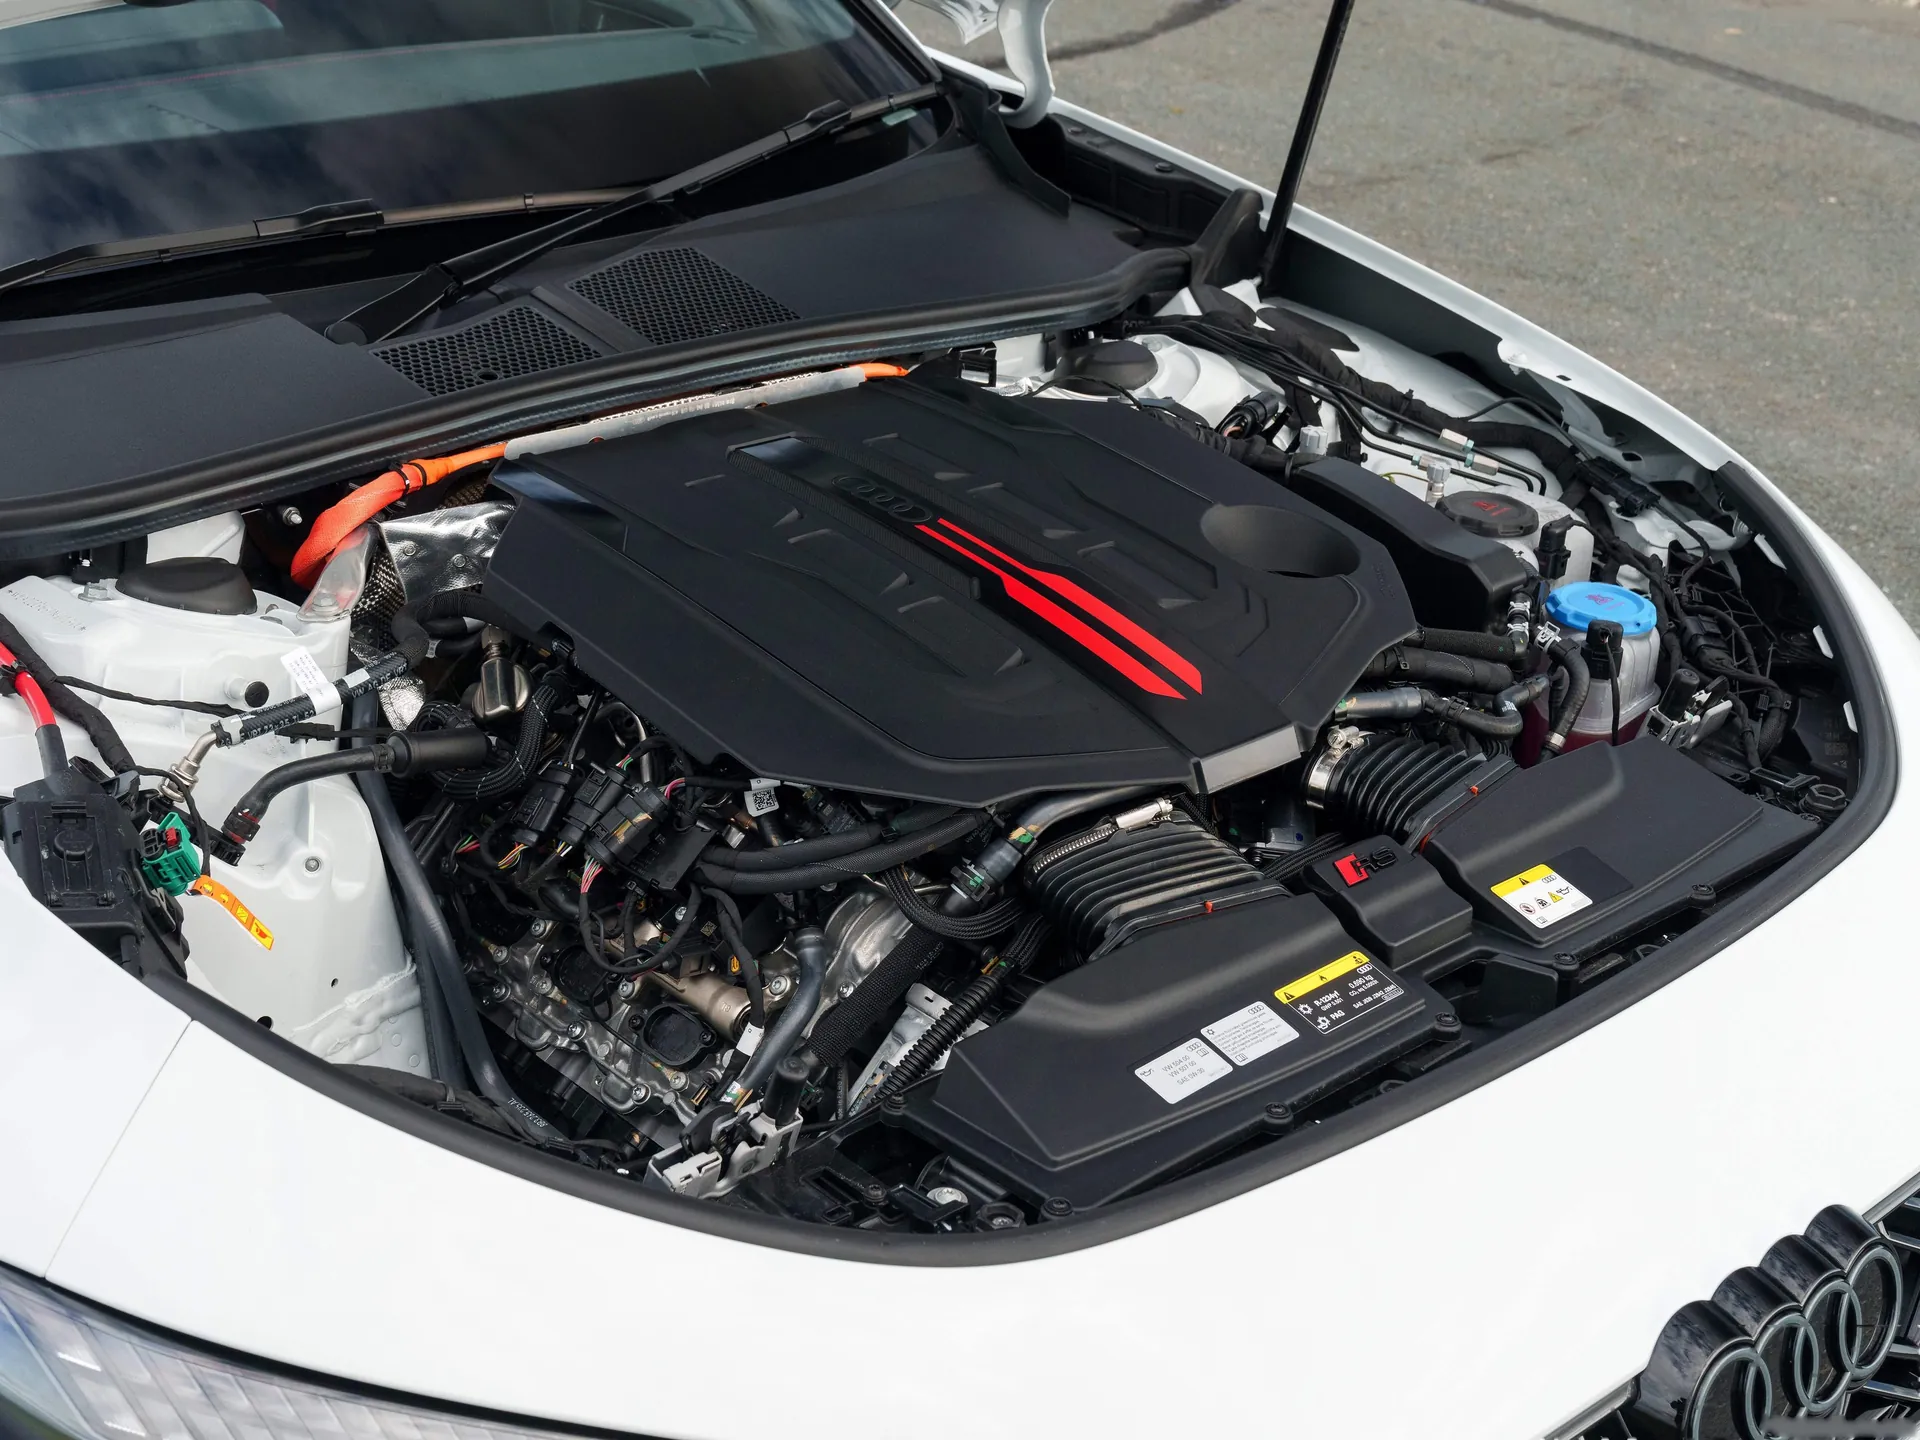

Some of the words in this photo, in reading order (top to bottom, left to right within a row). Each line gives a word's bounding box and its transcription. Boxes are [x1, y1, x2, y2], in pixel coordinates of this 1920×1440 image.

[351, 687, 365, 698] VW
[368, 680, 379, 691] AG
[1345, 845, 1398, 881] RS
[1362, 974, 1375, 982] kg
[1313, 990, 1341, 1007] R-1234yf
[1329, 1009, 1345, 1020] PAG
[1161, 1063, 1173, 1072] VW
[1171, 1058, 1183, 1067] 504
[1168, 1069, 1180, 1077] VW
[1178, 1063, 1189, 1072] 507
[1176, 1075, 1190, 1085] SAE
